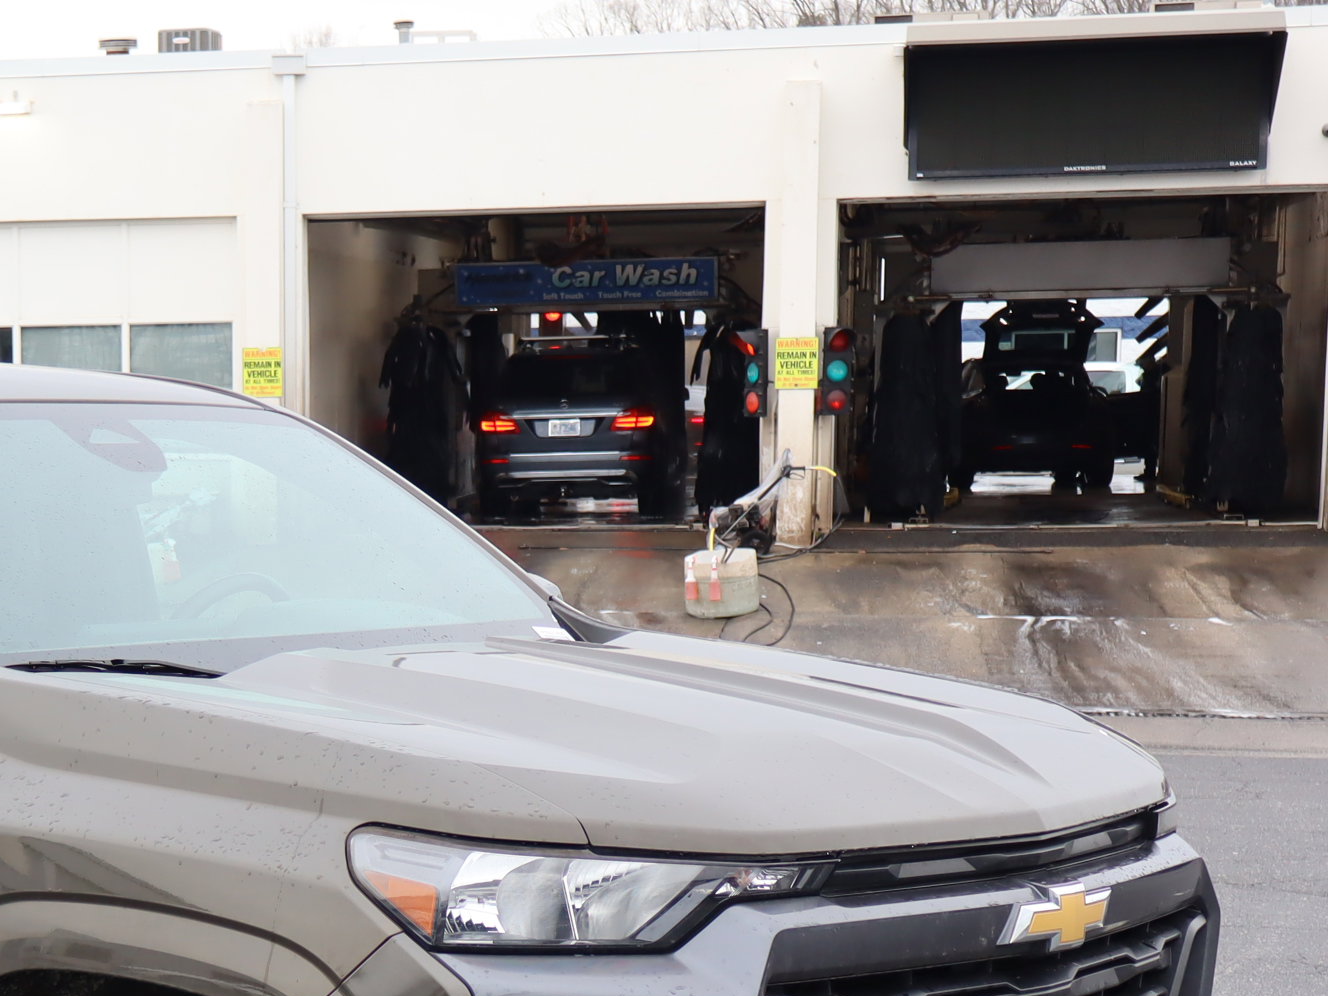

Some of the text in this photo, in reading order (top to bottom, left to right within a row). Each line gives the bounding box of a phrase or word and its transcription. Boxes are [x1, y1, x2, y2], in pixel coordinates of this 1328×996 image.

[551, 265, 606, 288] Car
[615, 263, 698, 287] Wash
[560, 291, 584, 300] Touch
[598, 290, 622, 299] Touch
[623, 290, 642, 298] Free
[656, 289, 709, 298] Combination
[809, 351, 817, 359] IN
[243, 361, 272, 369] REMAIN
[779, 361, 813, 369] VEHICLE
[247, 370, 278, 378] VEHICLE
